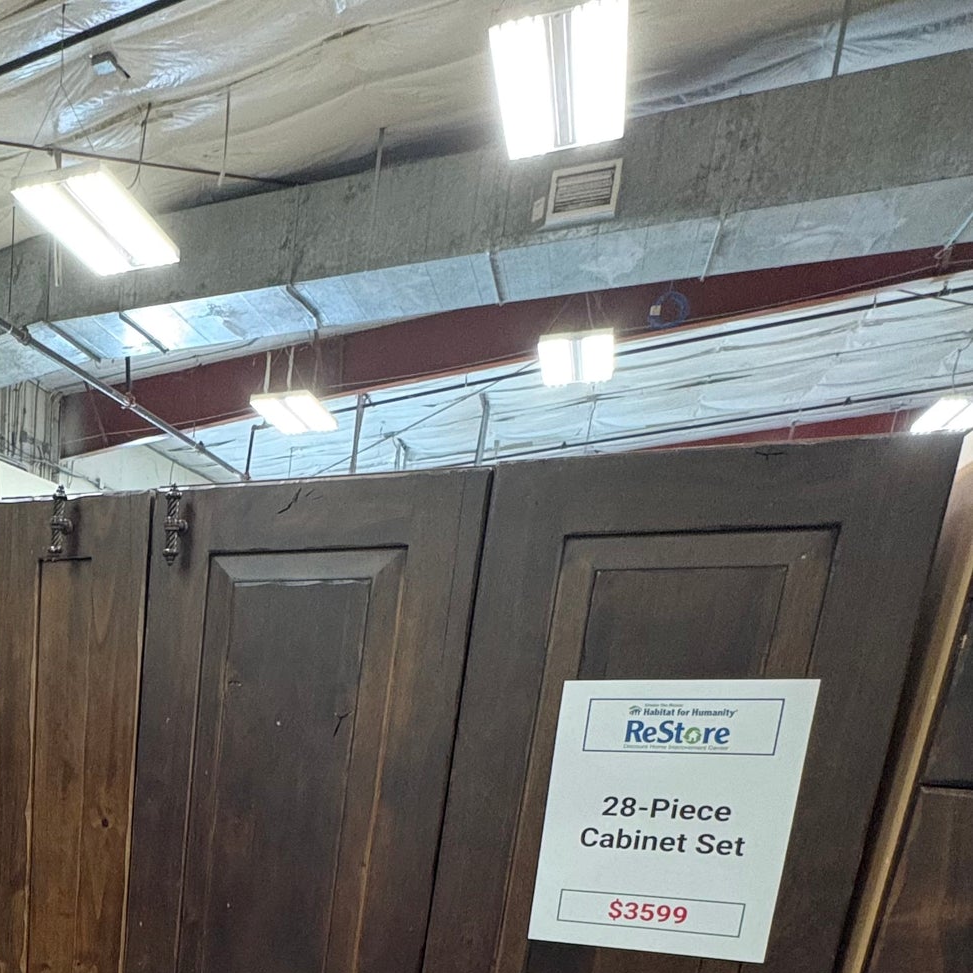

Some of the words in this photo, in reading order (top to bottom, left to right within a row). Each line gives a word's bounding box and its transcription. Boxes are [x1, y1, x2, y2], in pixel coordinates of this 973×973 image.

[643, 708, 676, 717] Habitat
[676, 708, 690, 717] for
[691, 708, 736, 718] Humanity
[624, 720, 731, 744] ReStore
[601, 796, 732, 821] 28-Piece
[580, 827, 688, 853] Cabinet
[695, 832, 746, 857] Set
[608, 898, 688, 924] $3599
